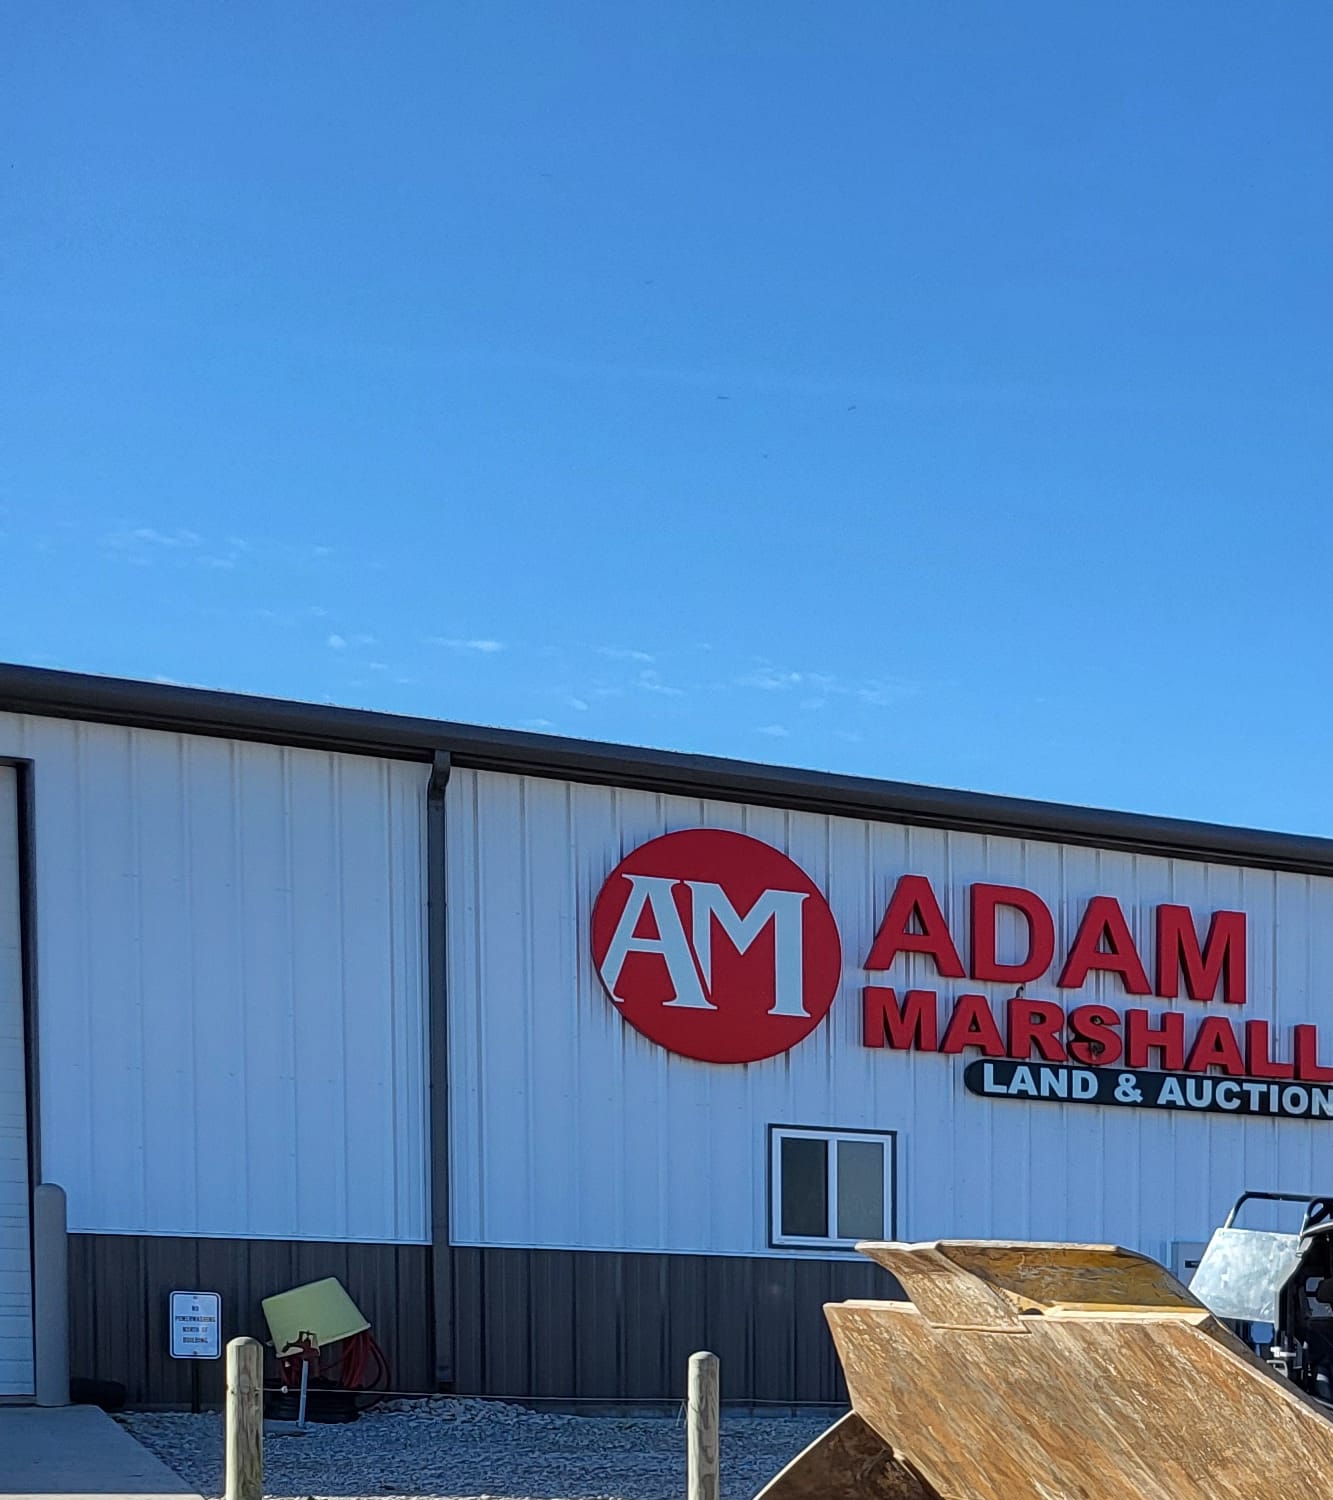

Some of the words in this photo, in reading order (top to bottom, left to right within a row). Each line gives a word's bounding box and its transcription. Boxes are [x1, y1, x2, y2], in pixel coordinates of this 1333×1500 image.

[600, 873, 811, 1018] AM
[863, 874, 1247, 1004] ADAM
[983, 1063, 1099, 1100] LAND
[1113, 1073, 1143, 1103] &
